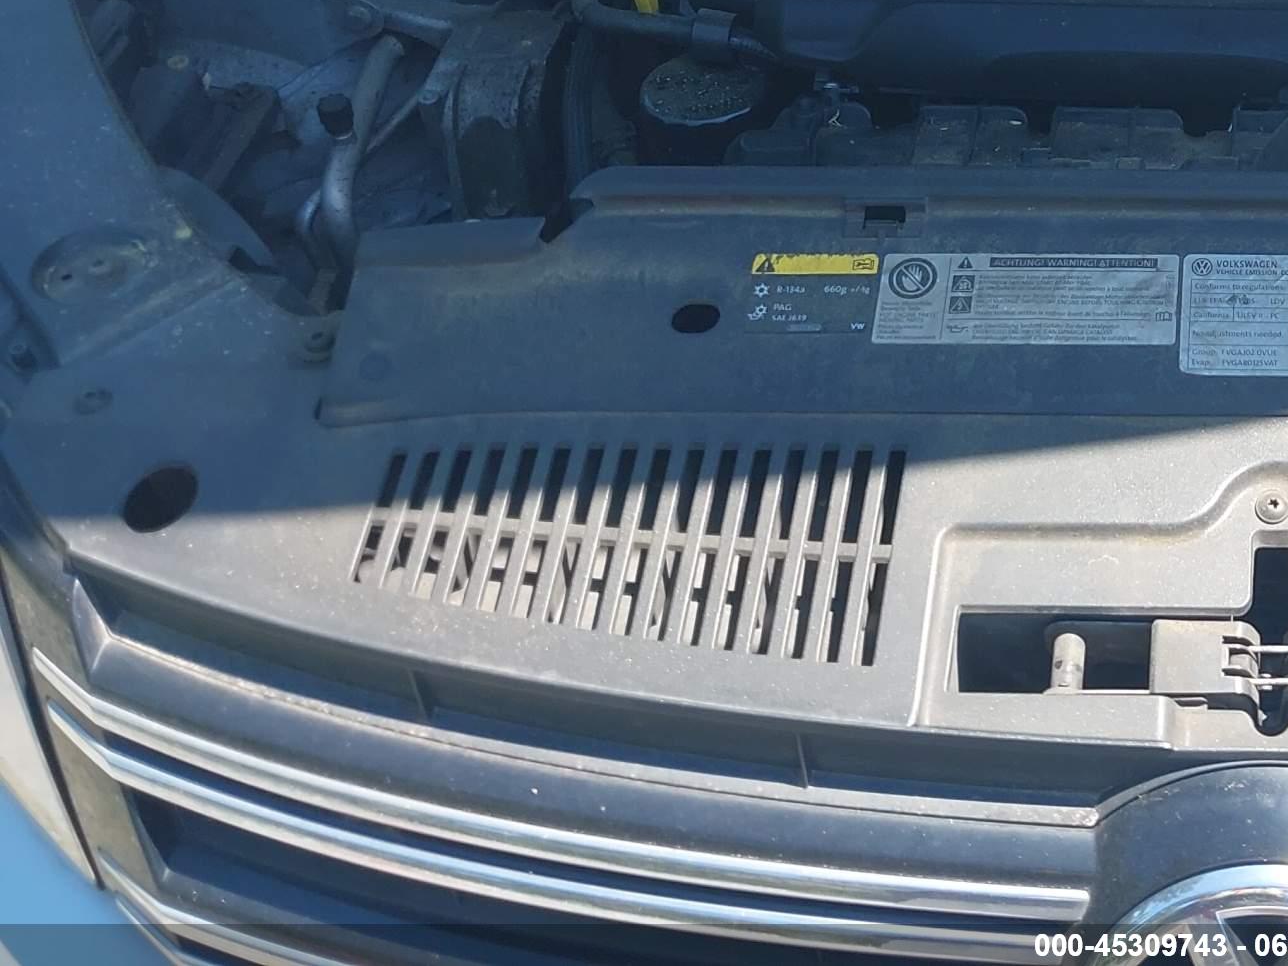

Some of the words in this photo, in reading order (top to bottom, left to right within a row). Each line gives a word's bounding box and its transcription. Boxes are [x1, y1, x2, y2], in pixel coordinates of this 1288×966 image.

[992, 258, 1045, 267] ACHTUNG!
[1047, 259, 1097, 267] WARNING!
[1099, 259, 1154, 268] ATTENTION!
[1216, 259, 1278, 268] VOLKSWAGEN
[823, 284, 848, 296] 660g
[772, 303, 793, 312] PAG
[850, 322, 866, 331] VW
